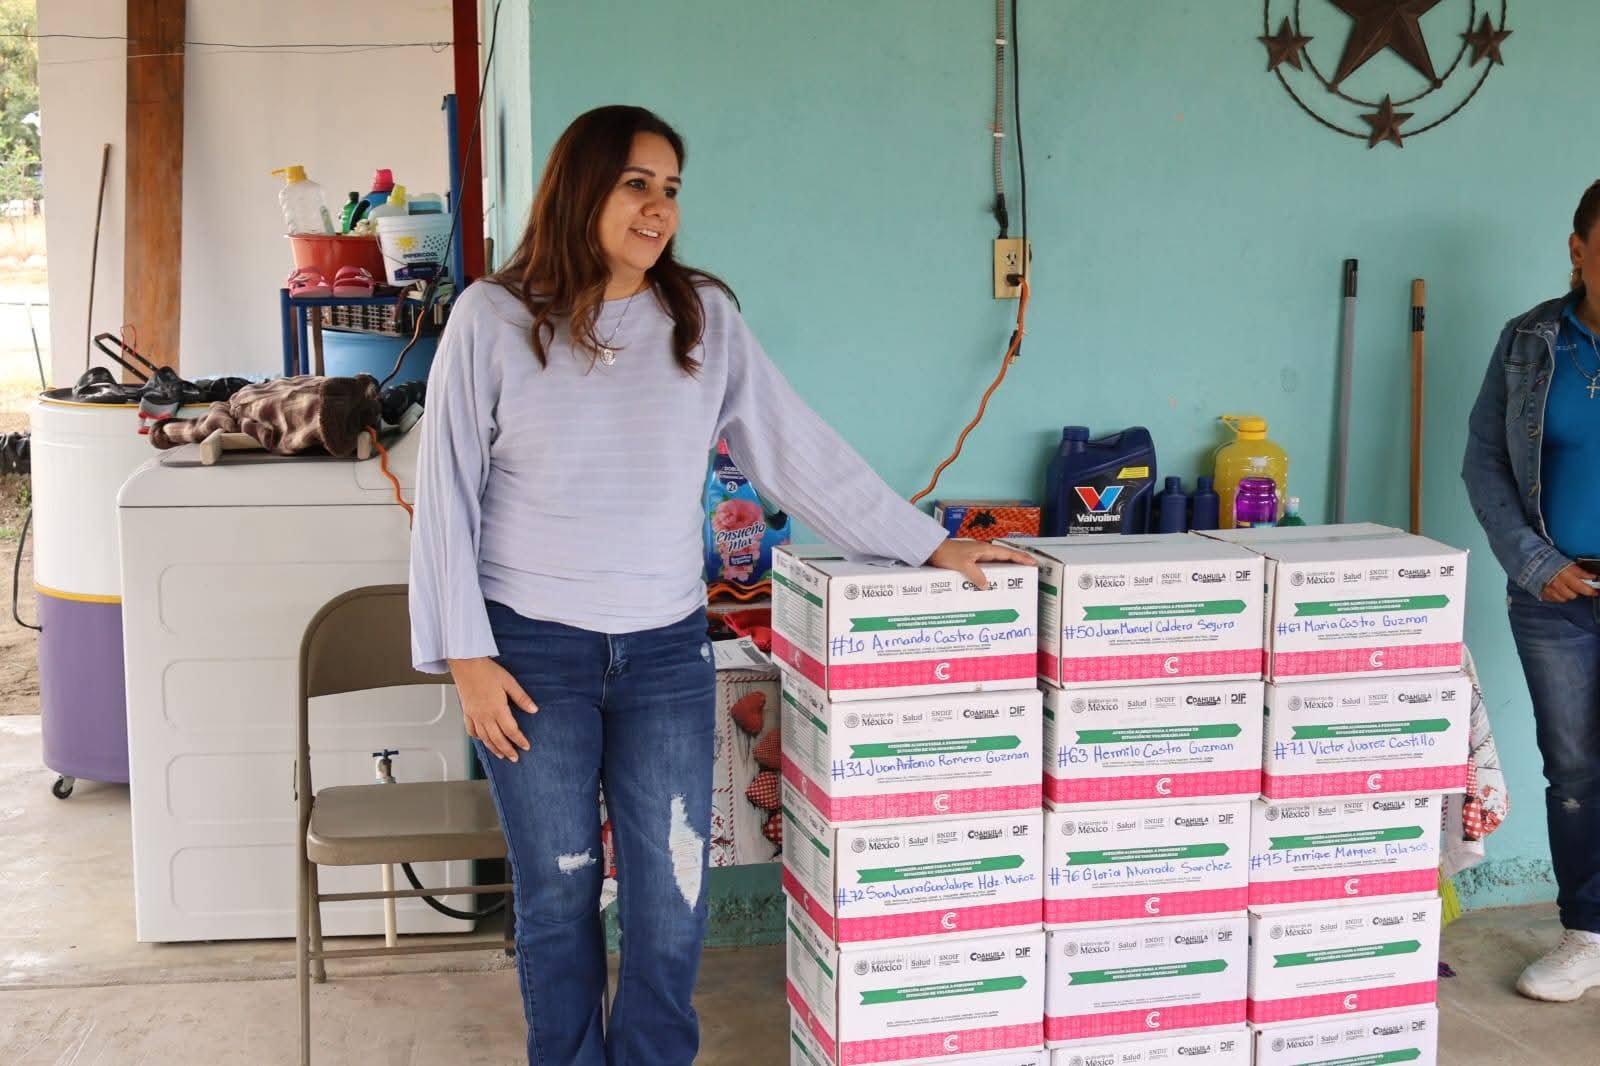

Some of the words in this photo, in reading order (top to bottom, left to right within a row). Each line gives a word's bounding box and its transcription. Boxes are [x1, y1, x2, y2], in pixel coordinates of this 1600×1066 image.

[1076, 513, 1121, 522] Valvoline
[1236, 570, 1250, 579] DIF
[1398, 568, 1431, 577] COAHUILA
[1440, 566, 1454, 574] DIF
[1192, 572, 1226, 581] COAHUILA
[1306, 575, 1335, 584] México
[1008, 578, 1023, 587] DIF
[1094, 578, 1125, 588] México
[861, 587, 893, 598] México
[902, 584, 922, 593] Salud
[1277, 623, 1300, 635] #67
[1304, 618, 1338, 633] Maria
[1339, 616, 1375, 629] Castro
[1383, 615, 1427, 626] Guzman
[1064, 625, 1094, 640] #50
[1097, 624, 1120, 638] Juan
[1121, 621, 1153, 635] Manuel
[1198, 620, 1234, 630] Segura
[831, 636, 864, 656] #10
[872, 633, 931, 651] Armando
[933, 628, 974, 642] Castro
[978, 627, 1032, 643] Guzman
[1186, 695, 1221, 705] COAHUILA
[1231, 694, 1246, 702] DIF
[1398, 693, 1432, 702] COAHUILA
[1441, 691, 1456, 700] DIF
[1087, 702, 1118, 711] México
[1304, 699, 1333, 708] México
[963, 709, 999, 718] COAHUILA
[1010, 706, 1025, 715] DIF
[861, 717, 893, 726] México
[1274, 741, 1305, 760] #71
[1308, 740, 1344, 756] Victor
[1347, 739, 1385, 753] Juarez
[1389, 735, 1435, 749] Castillo
[1058, 745, 1088, 768] #63
[1094, 745, 1140, 763] Hermilo
[1143, 743, 1182, 758] Castro
[1189, 742, 1234, 754] Guzman
[831, 759, 865, 781] #31
[866, 759, 896, 777] Juan
[896, 756, 935, 771] Antonio
[939, 754, 981, 766] Romero
[986, 750, 1029, 763] Guzman
[1373, 801, 1405, 810] COAHUILA
[1415, 798, 1428, 806] DIF
[1219, 814, 1234, 823] DIF
[1281, 809, 1310, 819] México
[1175, 817, 1208, 826] COAHUILA
[1013, 825, 1028, 834] DIF
[1078, 824, 1108, 834] México
[968, 829, 1002, 839] COAHUILA
[868, 840, 899, 850] México
[1250, 853, 1282, 870] #95
[1048, 867, 1080, 887] #76
[1083, 868, 1121, 880] Gloria
[1127, 864, 1175, 879] Alvarado
[1181, 860, 1232, 874] Sanchez
[1004, 873, 1037, 885] Muñoz
[1413, 912, 1426, 921] DIF
[1320, 923, 1337, 931] Salud
[1218, 931, 1232, 940] DIF
[1285, 927, 1312, 937] México
[1175, 935, 1208, 945] COAHUILA
[1016, 947, 1031, 956] DIF
[1080, 945, 1110, 954] México
[970, 951, 1005, 962] COAHUILA
[911, 959, 930, 967] Salud
[872, 963, 902, 973] México
[1412, 1021, 1425, 1030] DIF
[1321, 1034, 1338, 1044] Salud
[1220, 1041, 1234, 1050] DIF
[1287, 1039, 1314, 1050] México
[1178, 1045, 1211, 1055] COAHUILA
[1085, 1058, 1114, 1066] México
[1122, 1053, 1141, 1062] Salud
